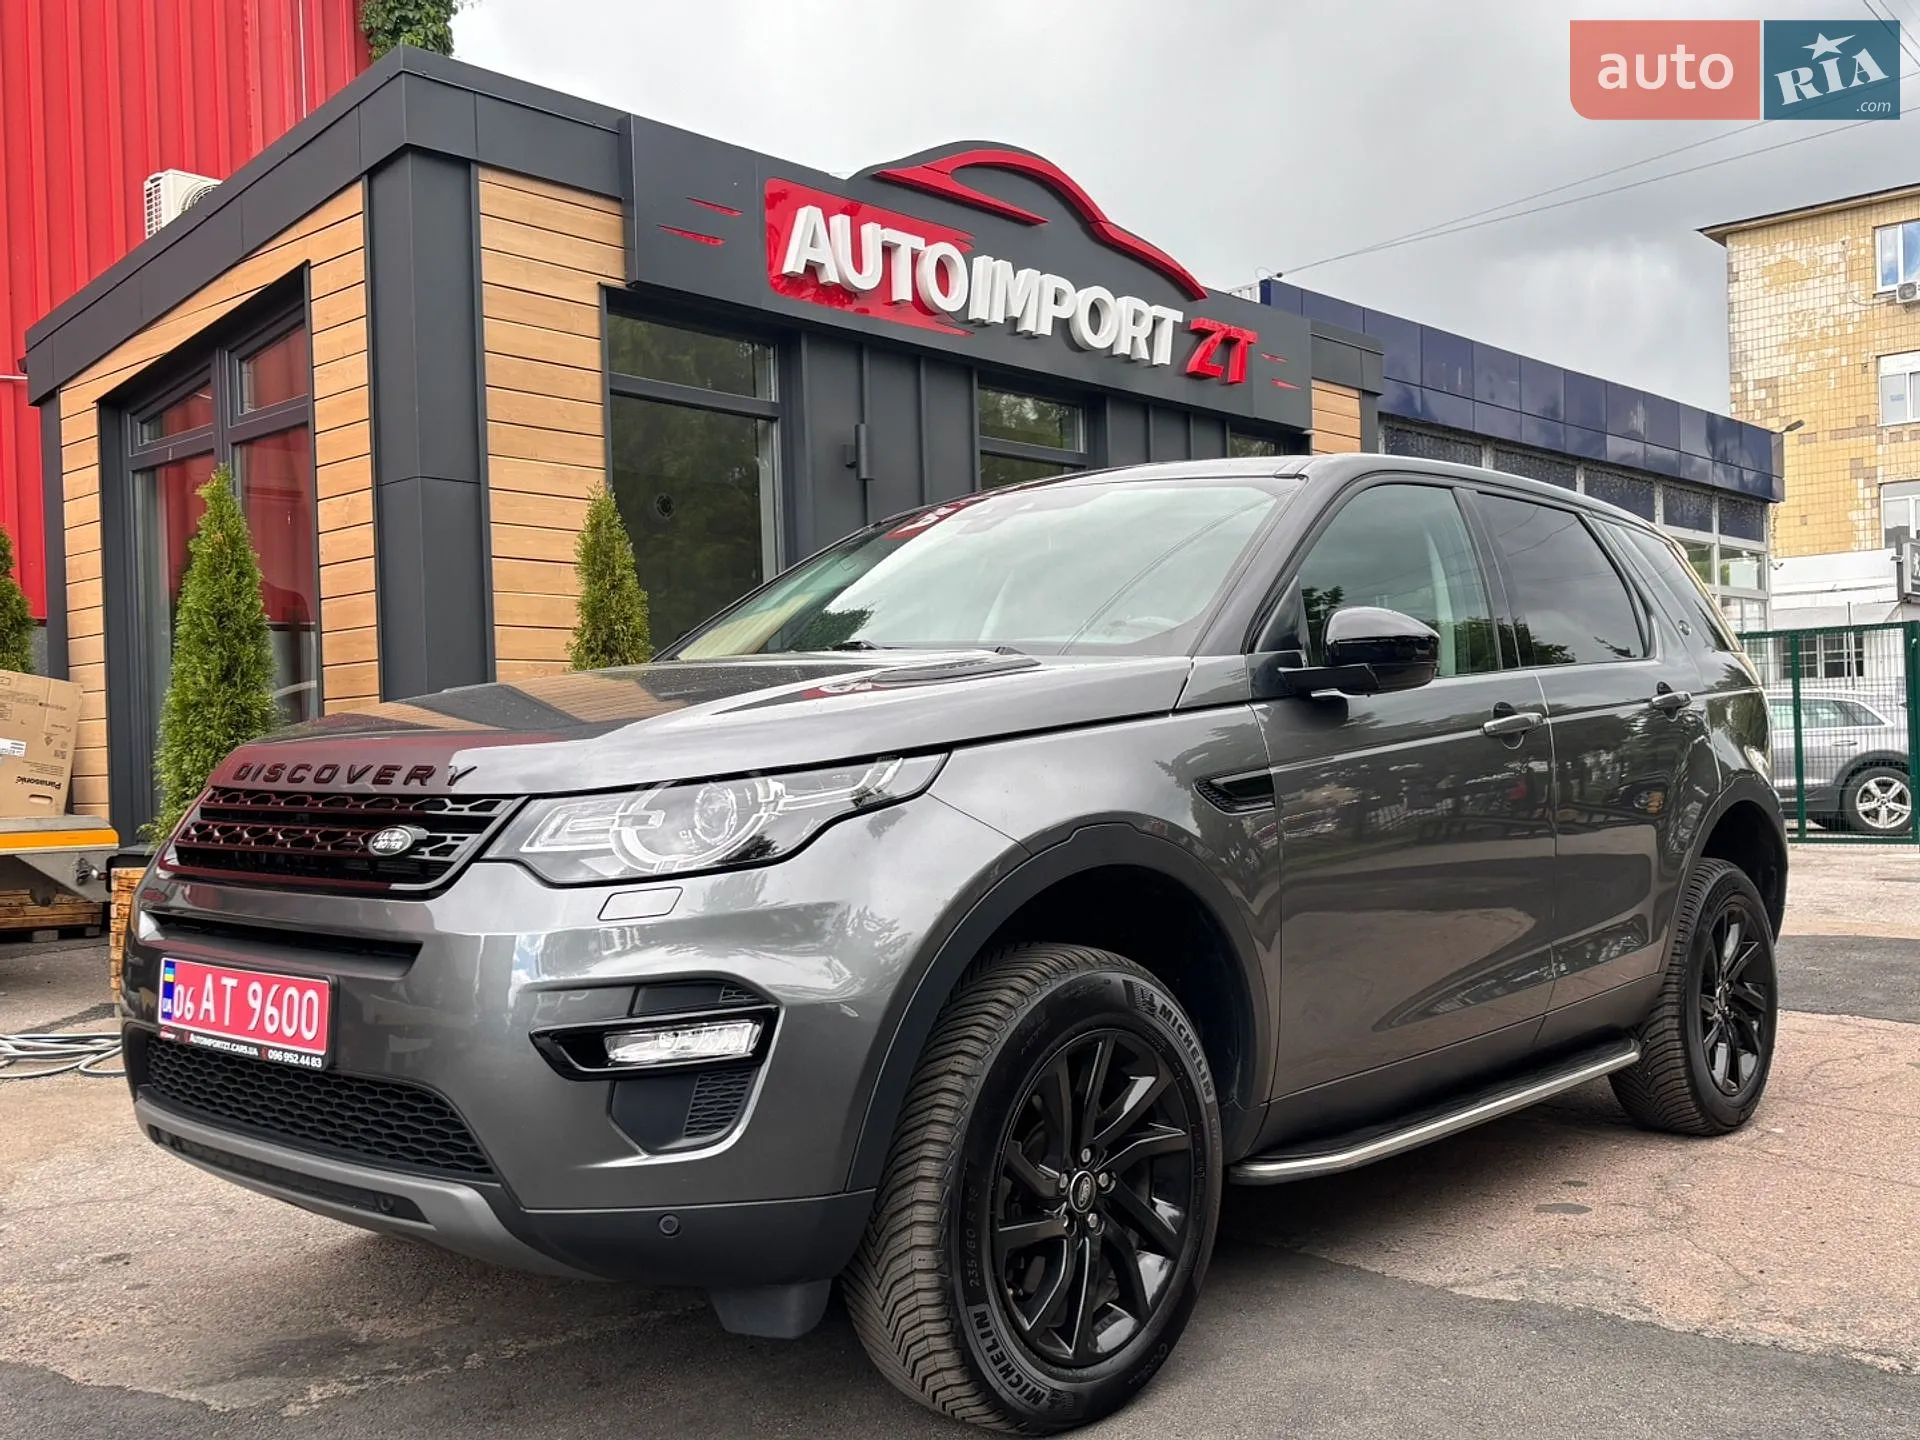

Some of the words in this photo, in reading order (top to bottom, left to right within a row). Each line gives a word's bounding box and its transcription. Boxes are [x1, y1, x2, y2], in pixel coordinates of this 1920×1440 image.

[781, 205, 1183, 368] AUTOIMPORT
[1184, 317, 1258, 384] ZT
[15, 775, 62, 790] Panasonic
[231, 762, 477, 788] DISCOVERY
[173, 984, 196, 1021] 06
[199, 973, 239, 1027] AT
[247, 981, 319, 1041] 9600
[1158, 1003, 1214, 1098] MICHELIN
[973, 1309, 1046, 1403] MICHELIN
